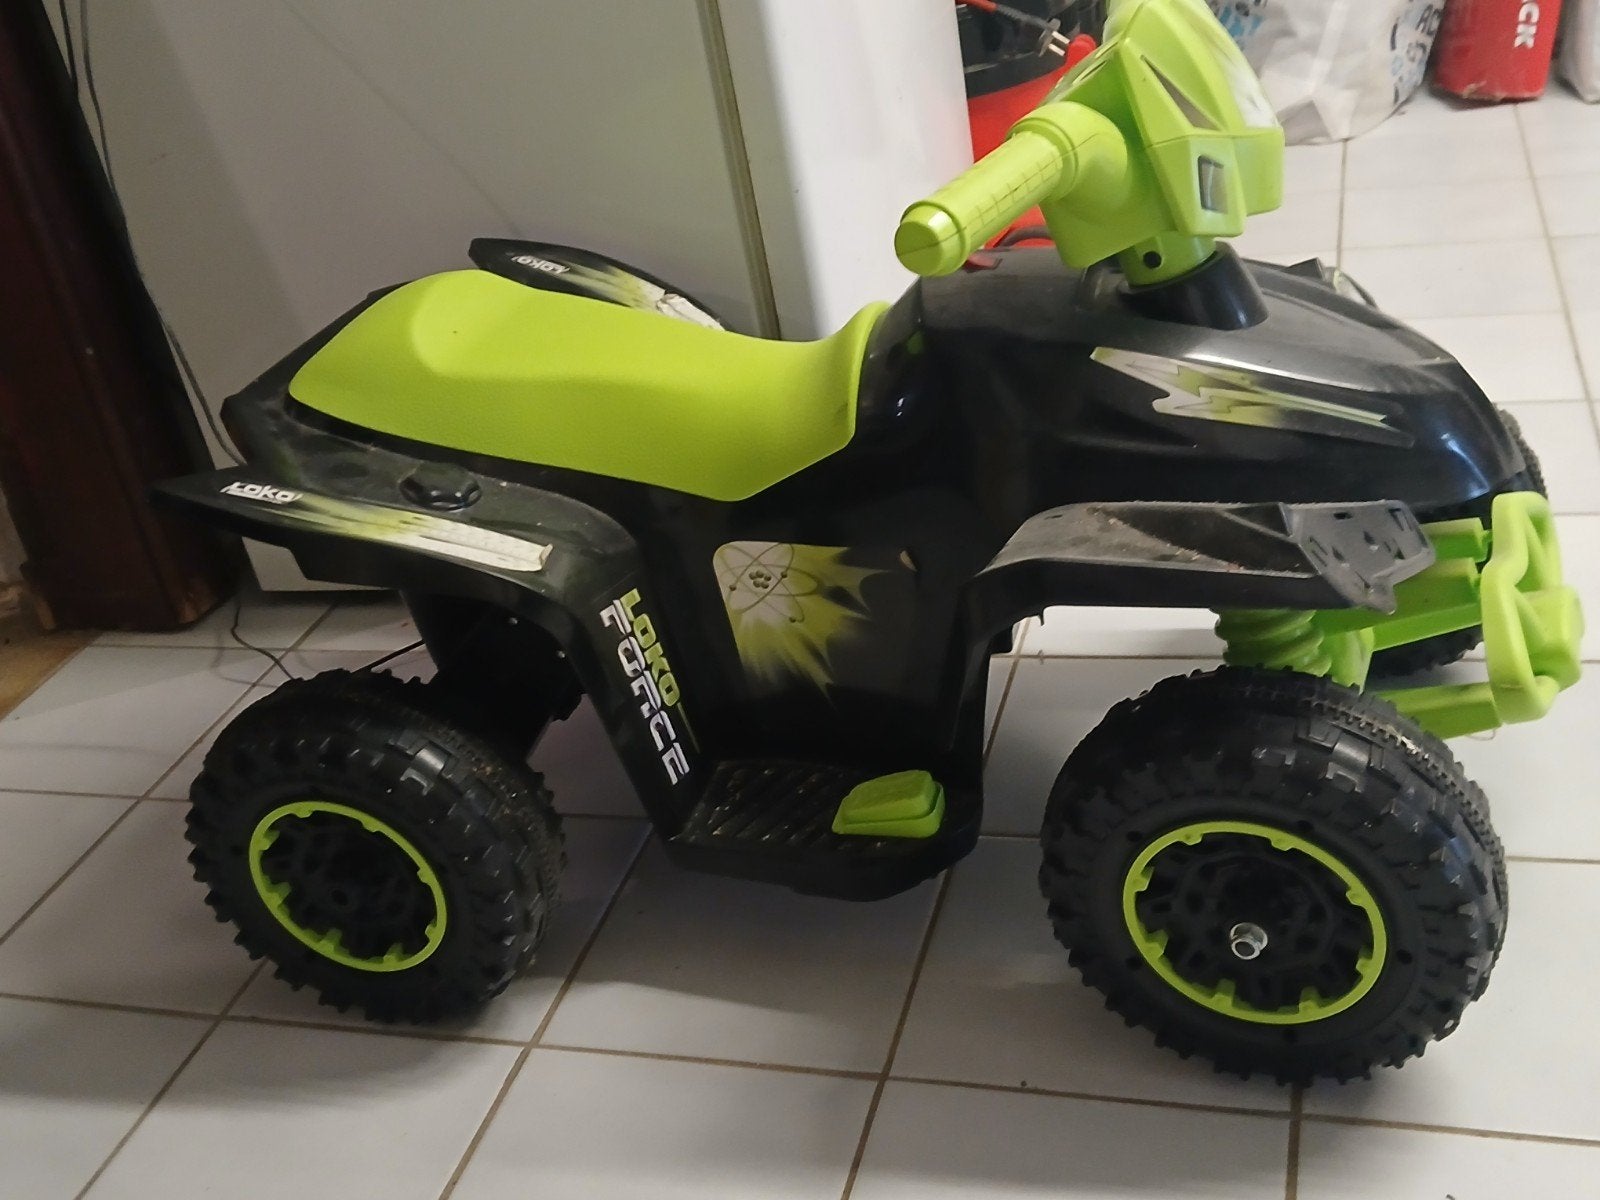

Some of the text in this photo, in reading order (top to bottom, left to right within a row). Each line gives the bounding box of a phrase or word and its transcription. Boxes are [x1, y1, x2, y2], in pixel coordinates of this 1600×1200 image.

[1514, 0, 1540, 48] CK
[599, 599, 690, 786] FORCE
[620, 587, 681, 707] LOKO
